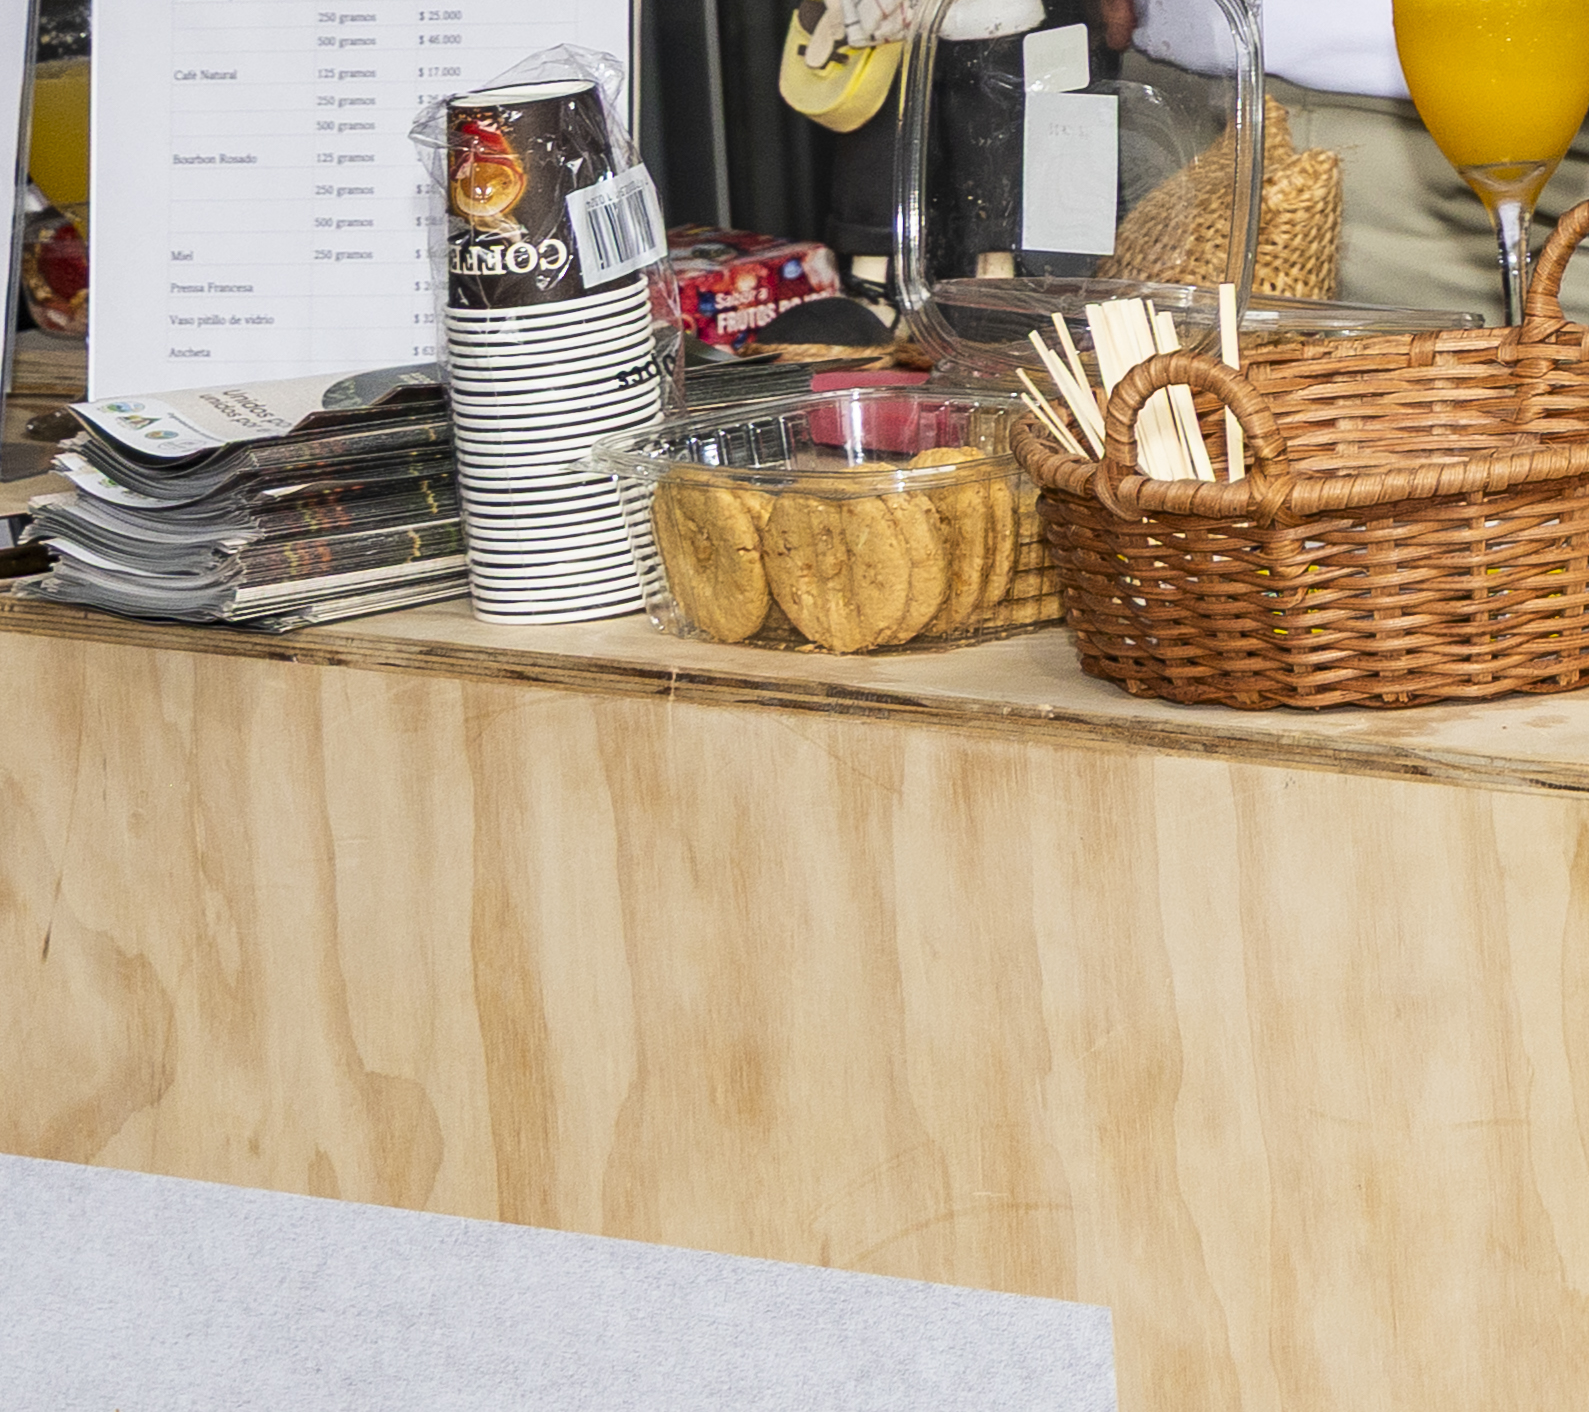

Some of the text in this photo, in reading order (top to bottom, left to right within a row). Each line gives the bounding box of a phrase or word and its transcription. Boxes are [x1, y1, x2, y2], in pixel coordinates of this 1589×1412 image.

[174, 69, 197, 81] Café
[200, 69, 237, 80] Natural
[173, 154, 216, 165] Bourbon
[219, 154, 257, 165] Rosado
[170, 250, 194, 261] Miel
[170, 282, 254, 293] Prensa Francesa
[715, 289, 757, 310] Sabor
[757, 287, 769, 301] a
[169, 315, 194, 325] Vaso
[229, 313, 242, 325] de
[244, 313, 274, 325] vidrio
[717, 302, 777, 335] FRUTOS
[169, 347, 211, 358] Ancheta
[200, 394, 242, 422] unidos
[222, 389, 275, 420] Unidos
